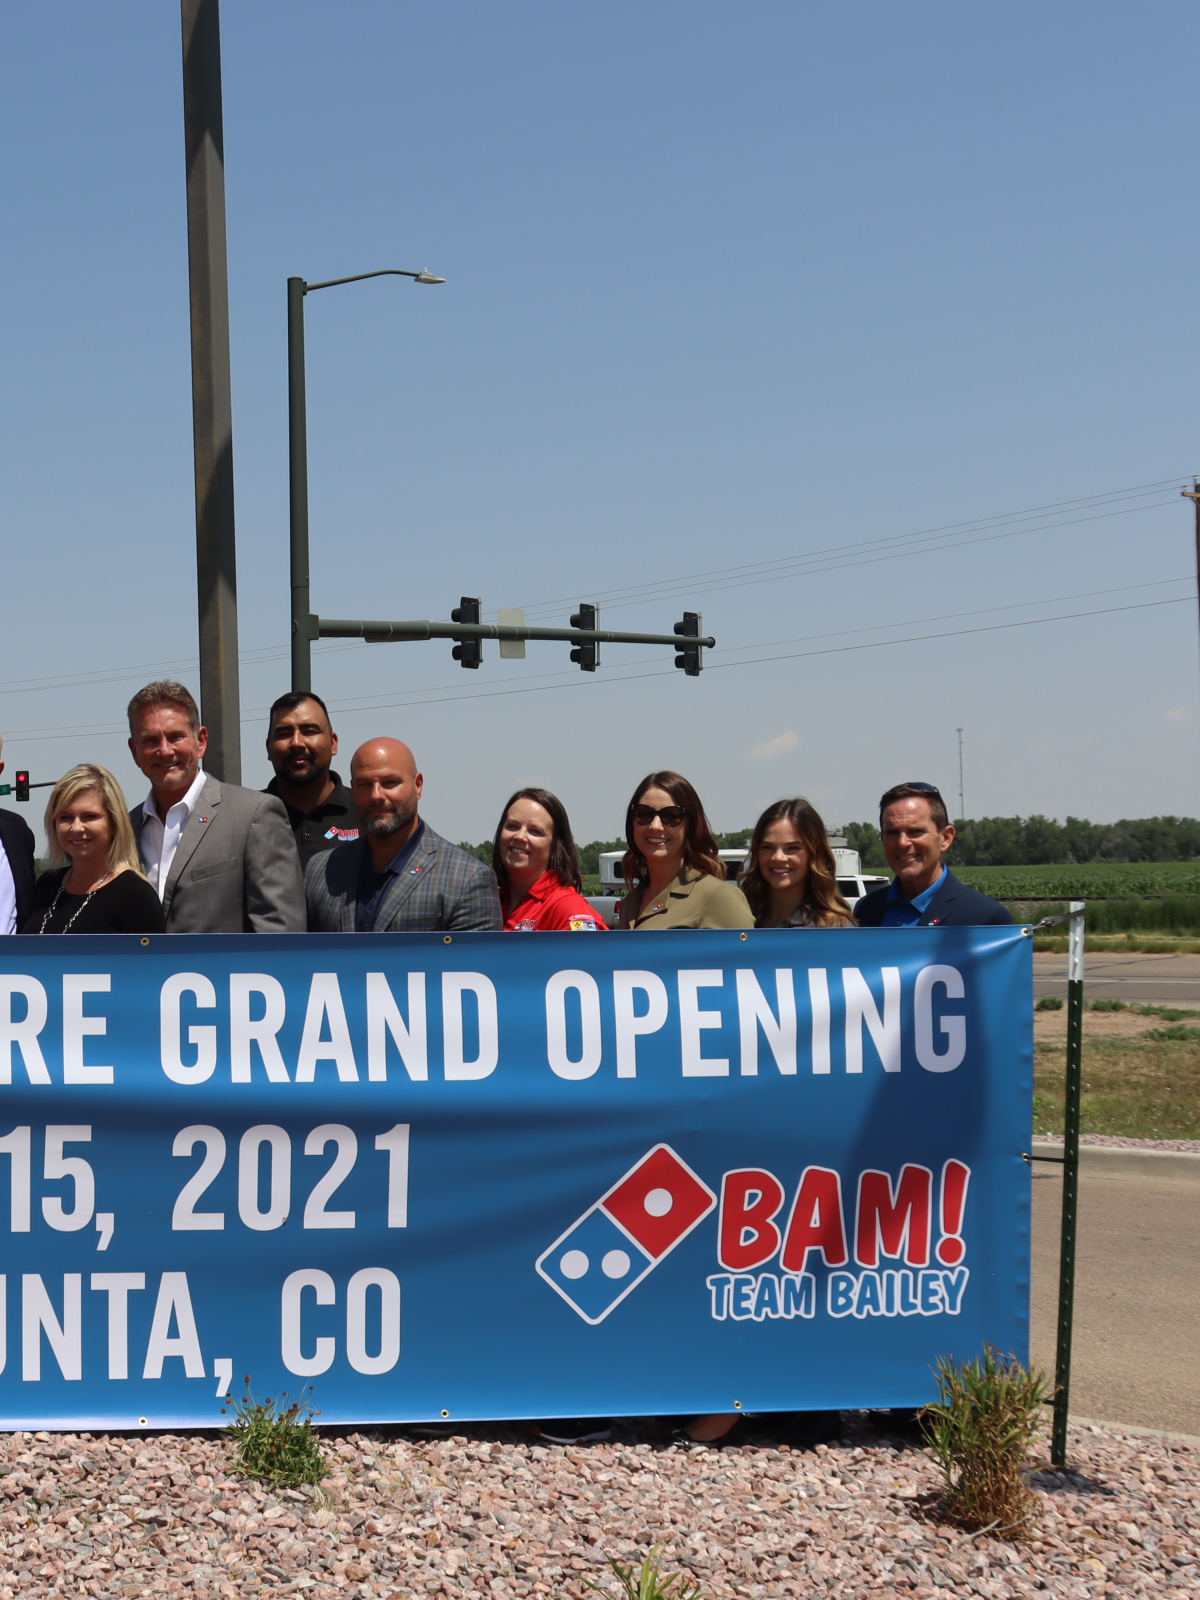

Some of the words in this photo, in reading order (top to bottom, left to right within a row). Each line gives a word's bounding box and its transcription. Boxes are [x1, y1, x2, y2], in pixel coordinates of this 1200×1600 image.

[160, 971, 499, 1085] GRAND
[546, 965, 966, 1081] OPENING
[172, 1124, 410, 1231] 2021
[717, 1158, 971, 1275] BAM!
[282, 1267, 401, 1377] CO
[706, 1272, 816, 1321] TEAM
[827, 1266, 970, 1319] BAILEY
